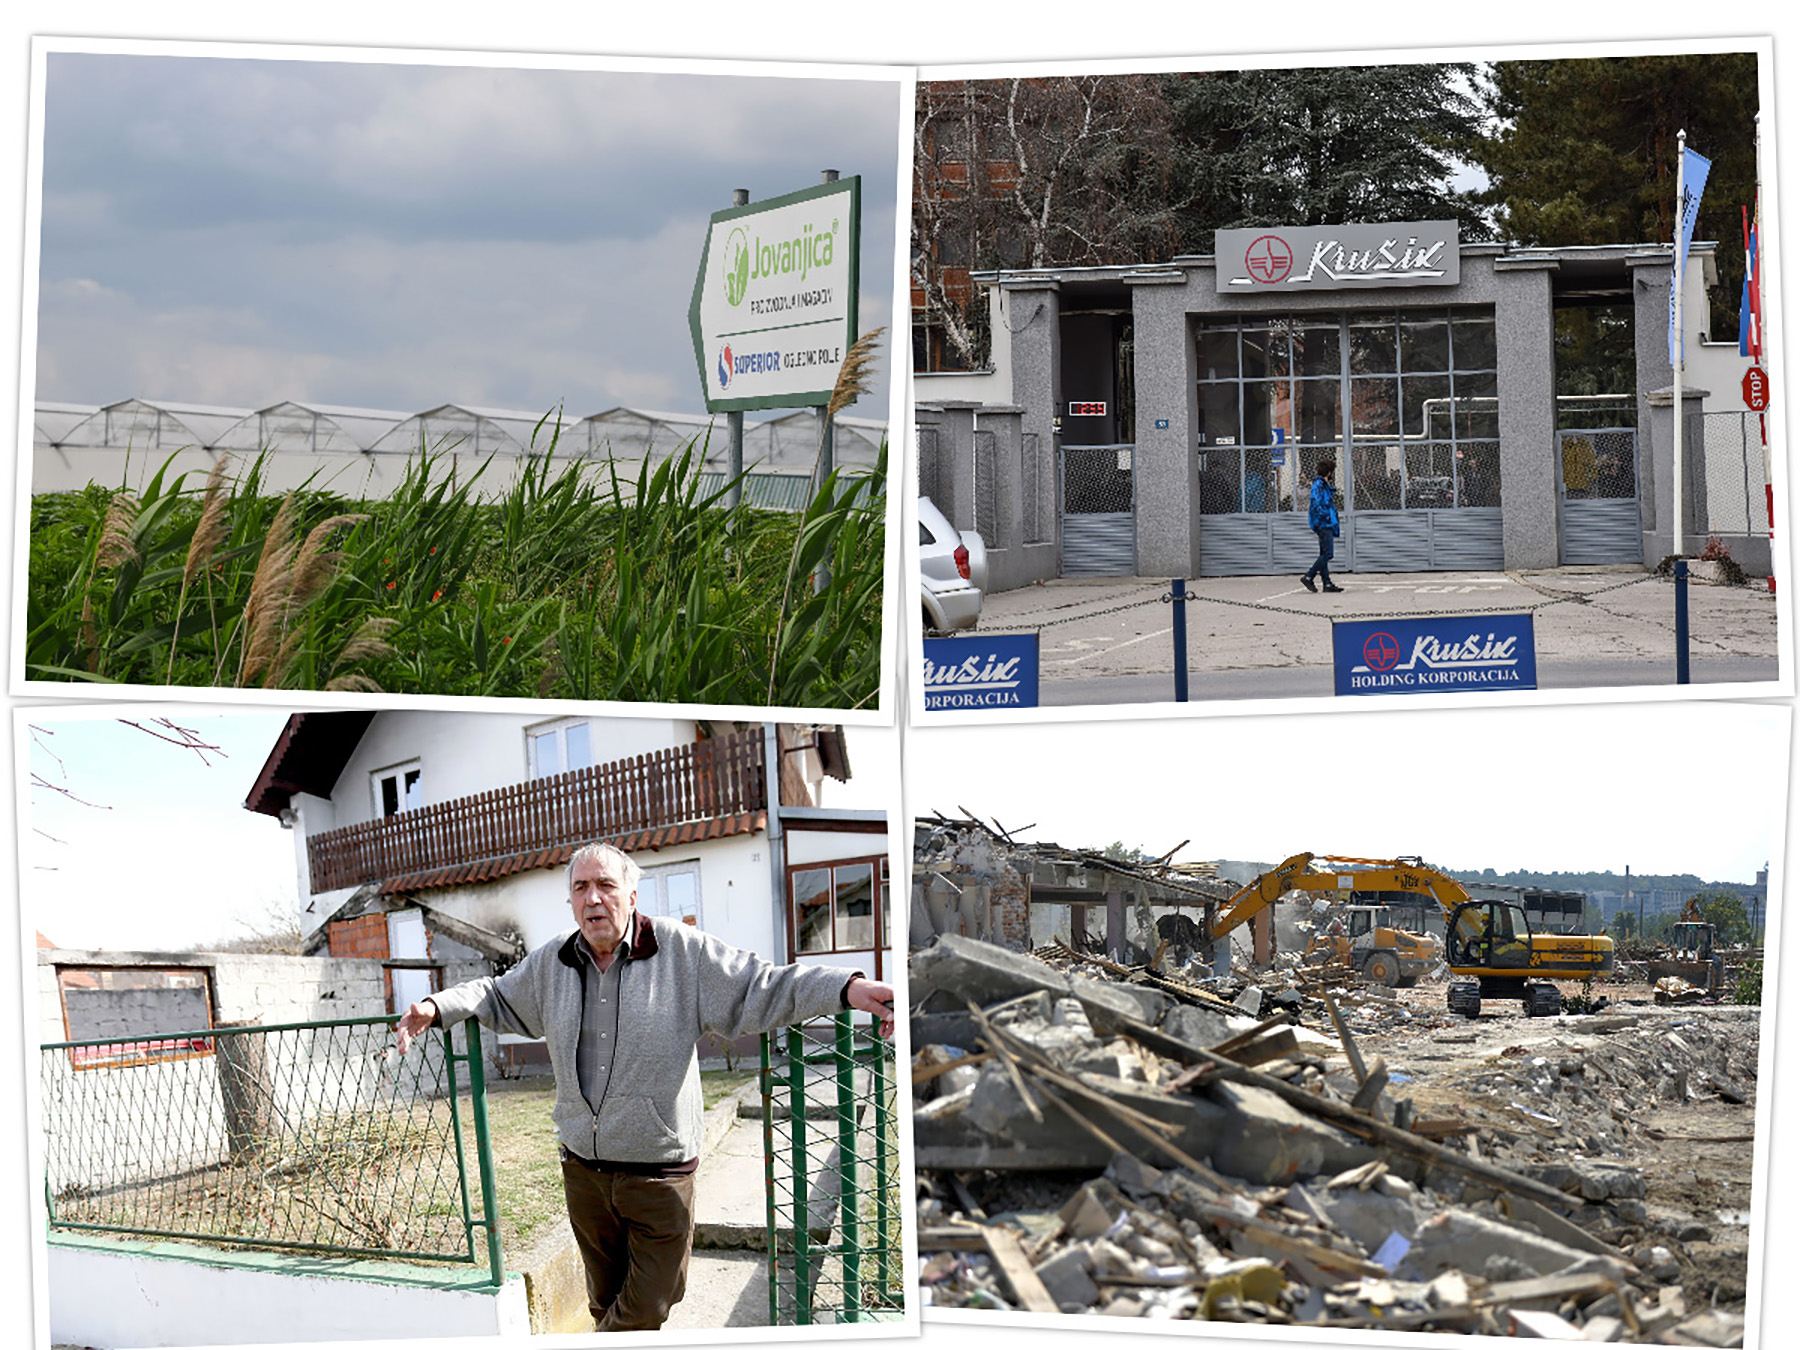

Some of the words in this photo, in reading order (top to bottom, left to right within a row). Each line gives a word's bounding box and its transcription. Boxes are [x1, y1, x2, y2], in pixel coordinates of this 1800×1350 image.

[751, 223, 833, 282] Jovanjica
[734, 351, 780, 374] SUPERIOR
[1750, 371, 1763, 407] STOP
[1351, 673, 1415, 688] HOLDING
[1418, 669, 1520, 685] KORPORACIJA
